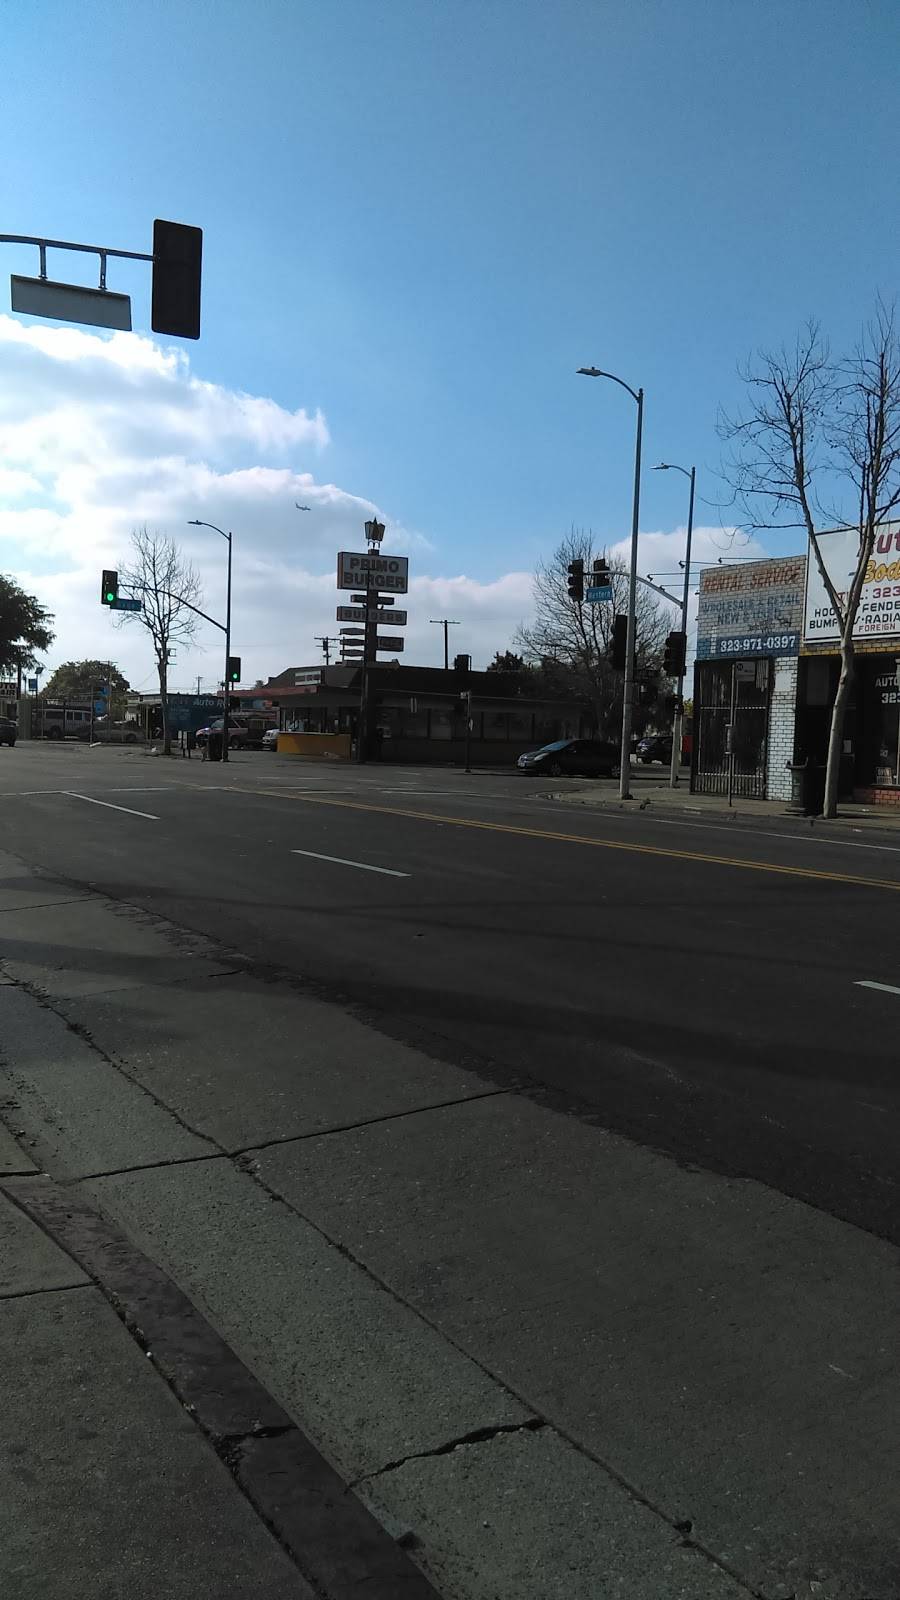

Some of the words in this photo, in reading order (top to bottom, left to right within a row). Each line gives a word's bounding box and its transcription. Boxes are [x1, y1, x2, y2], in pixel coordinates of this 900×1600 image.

[350, 557, 400, 573] PRIMO
[343, 572, 405, 588] BURGER
[858, 623, 896, 633] FOREIGN
[720, 635, 796, 653] 323-971-0397
